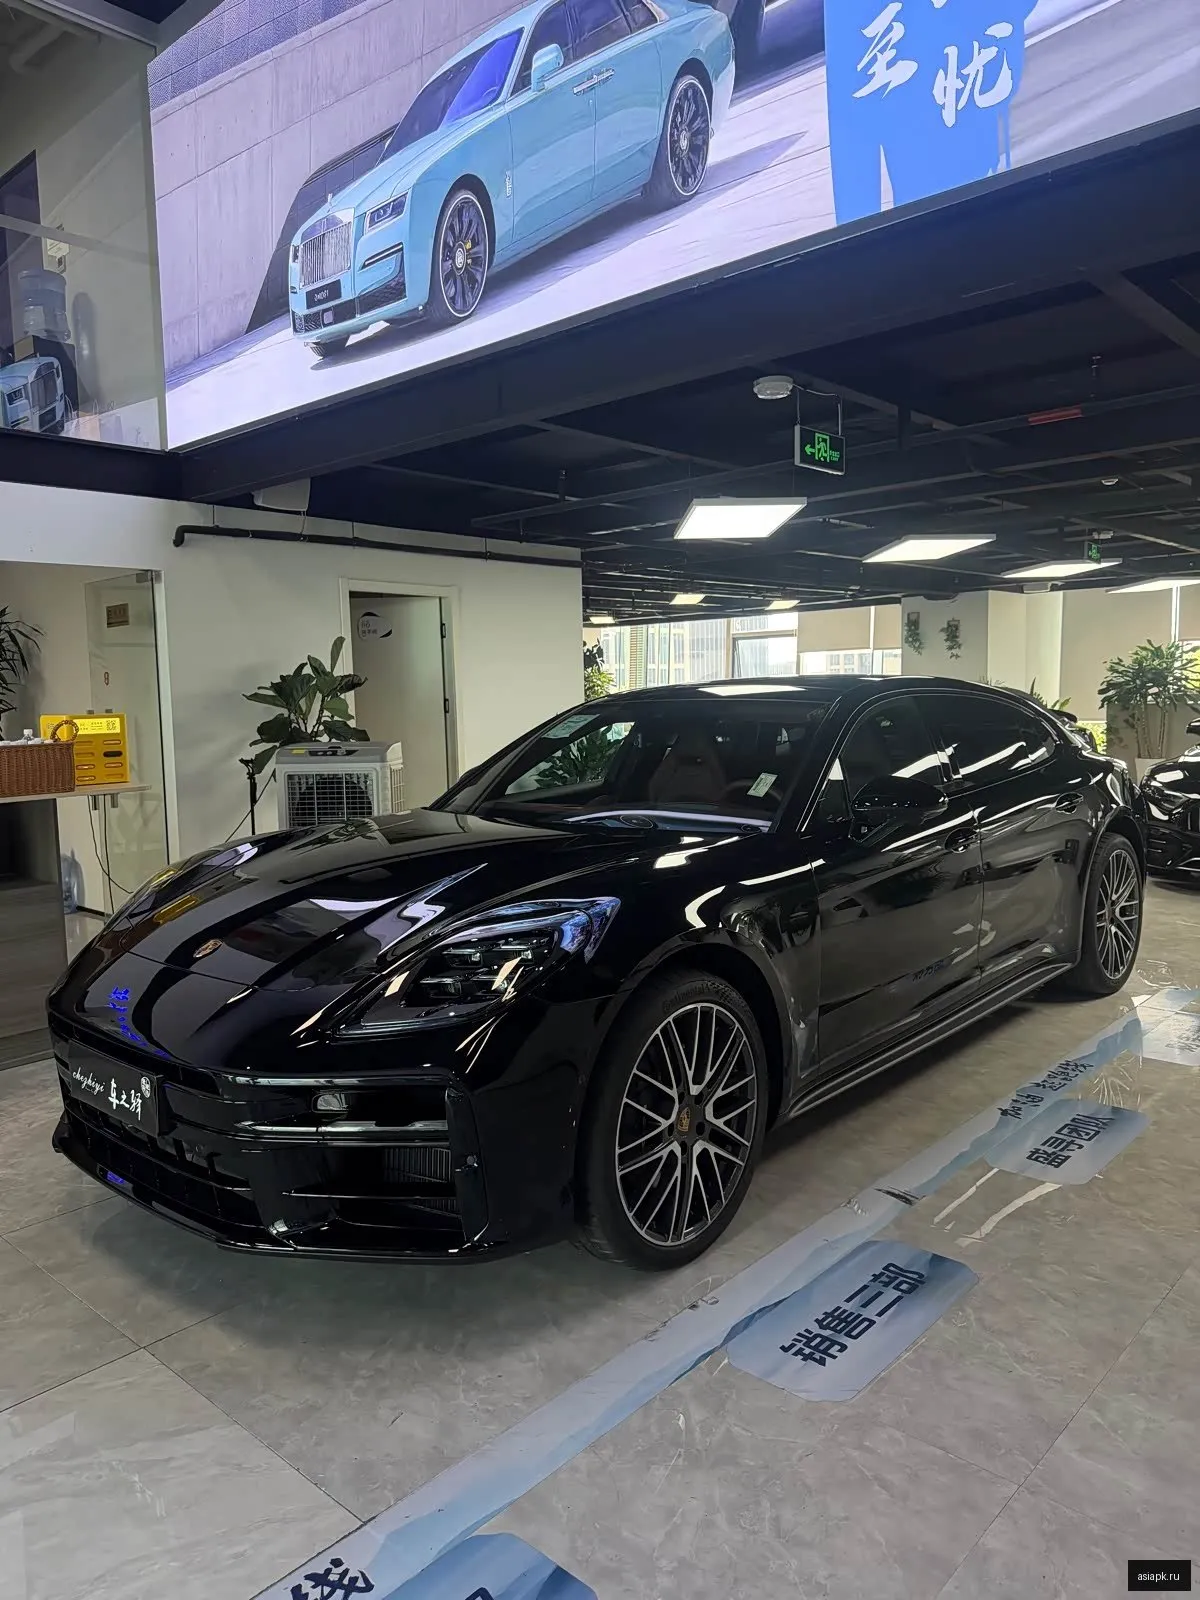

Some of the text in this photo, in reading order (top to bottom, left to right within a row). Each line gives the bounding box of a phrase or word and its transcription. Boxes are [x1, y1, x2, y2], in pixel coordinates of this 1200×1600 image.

[932, 22, 1014, 128] 忧
[1025, 1113, 1117, 1169] 盛寻团队
[779, 1262, 926, 1367] 销售三部
